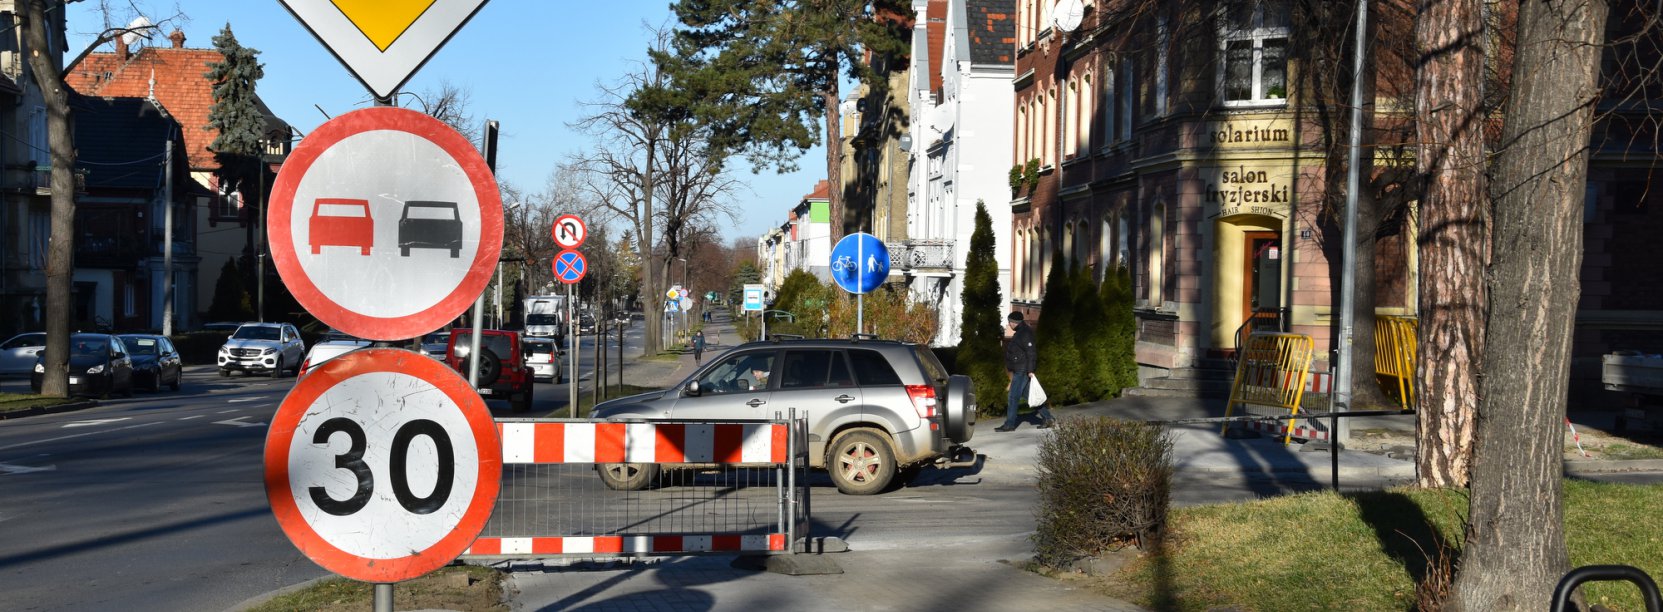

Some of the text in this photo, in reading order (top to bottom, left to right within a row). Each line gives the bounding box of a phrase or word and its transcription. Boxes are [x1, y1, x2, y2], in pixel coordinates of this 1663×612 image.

[1210, 125, 1289, 143] solarium
[1222, 165, 1268, 184] salon
[1205, 184, 1288, 206] fryzjerski
[1221, 205, 1273, 216] HAIR SHION
[308, 416, 455, 516] 30
